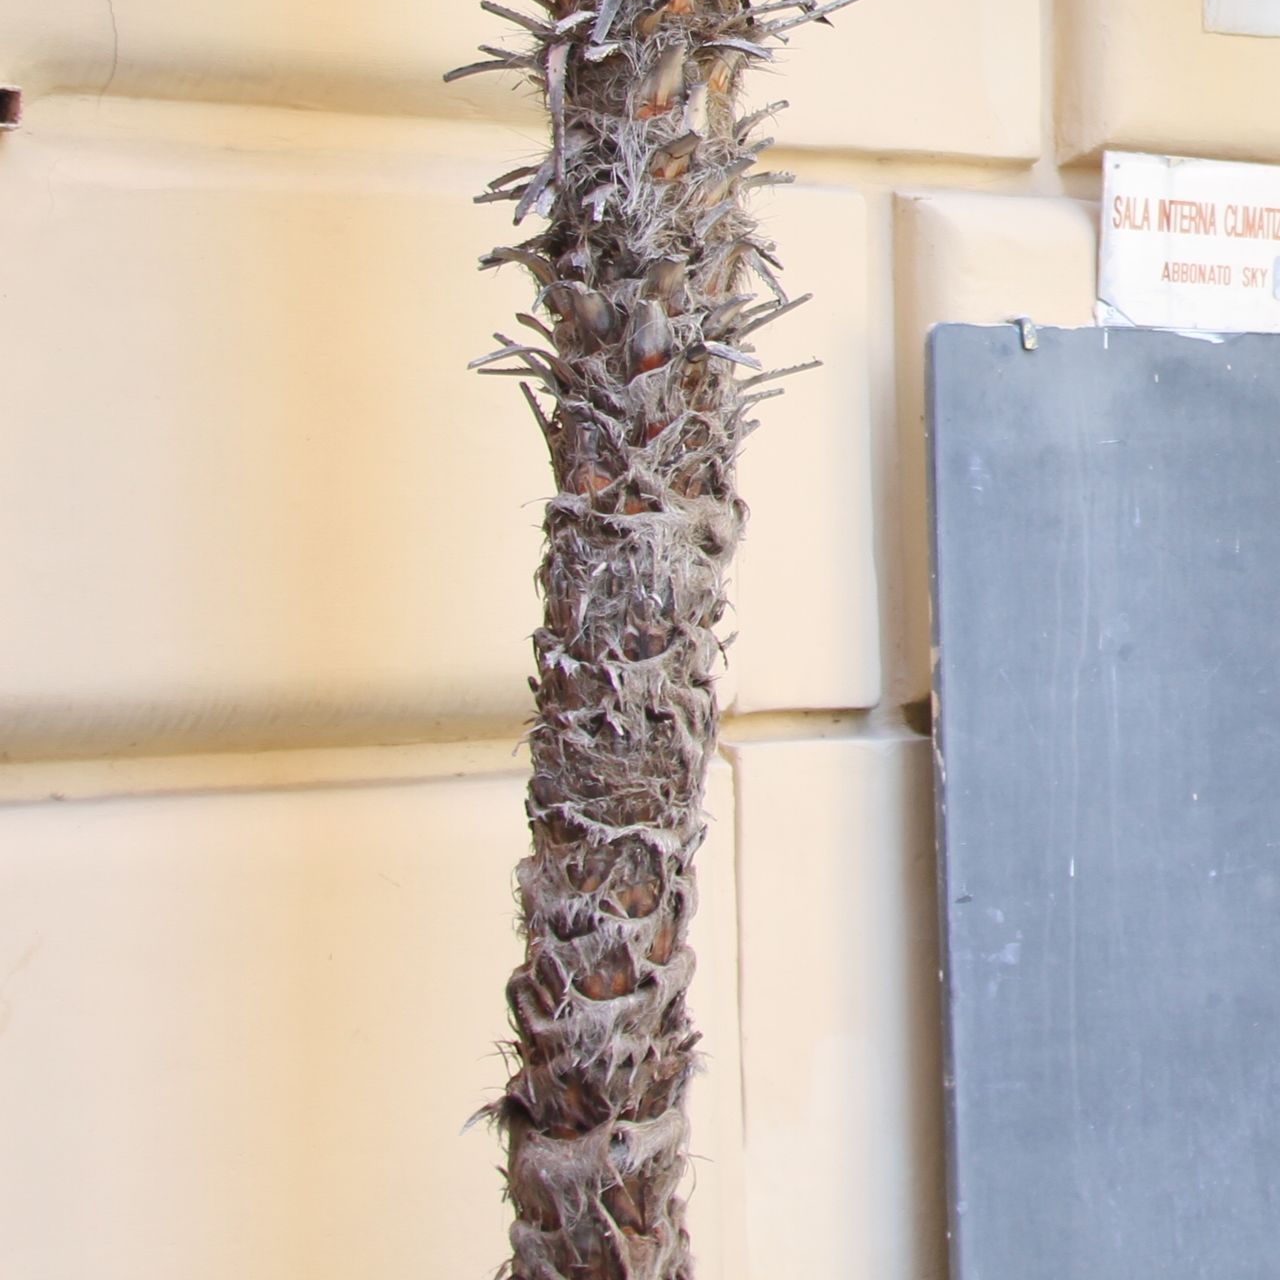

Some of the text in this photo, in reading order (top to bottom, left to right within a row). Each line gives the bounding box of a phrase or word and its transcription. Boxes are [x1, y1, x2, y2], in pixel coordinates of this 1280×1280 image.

[1113, 195, 1151, 231] SALA
[1157, 199, 1217, 236] INTERNA
[1161, 261, 1268, 288] ABBONATO SKY
